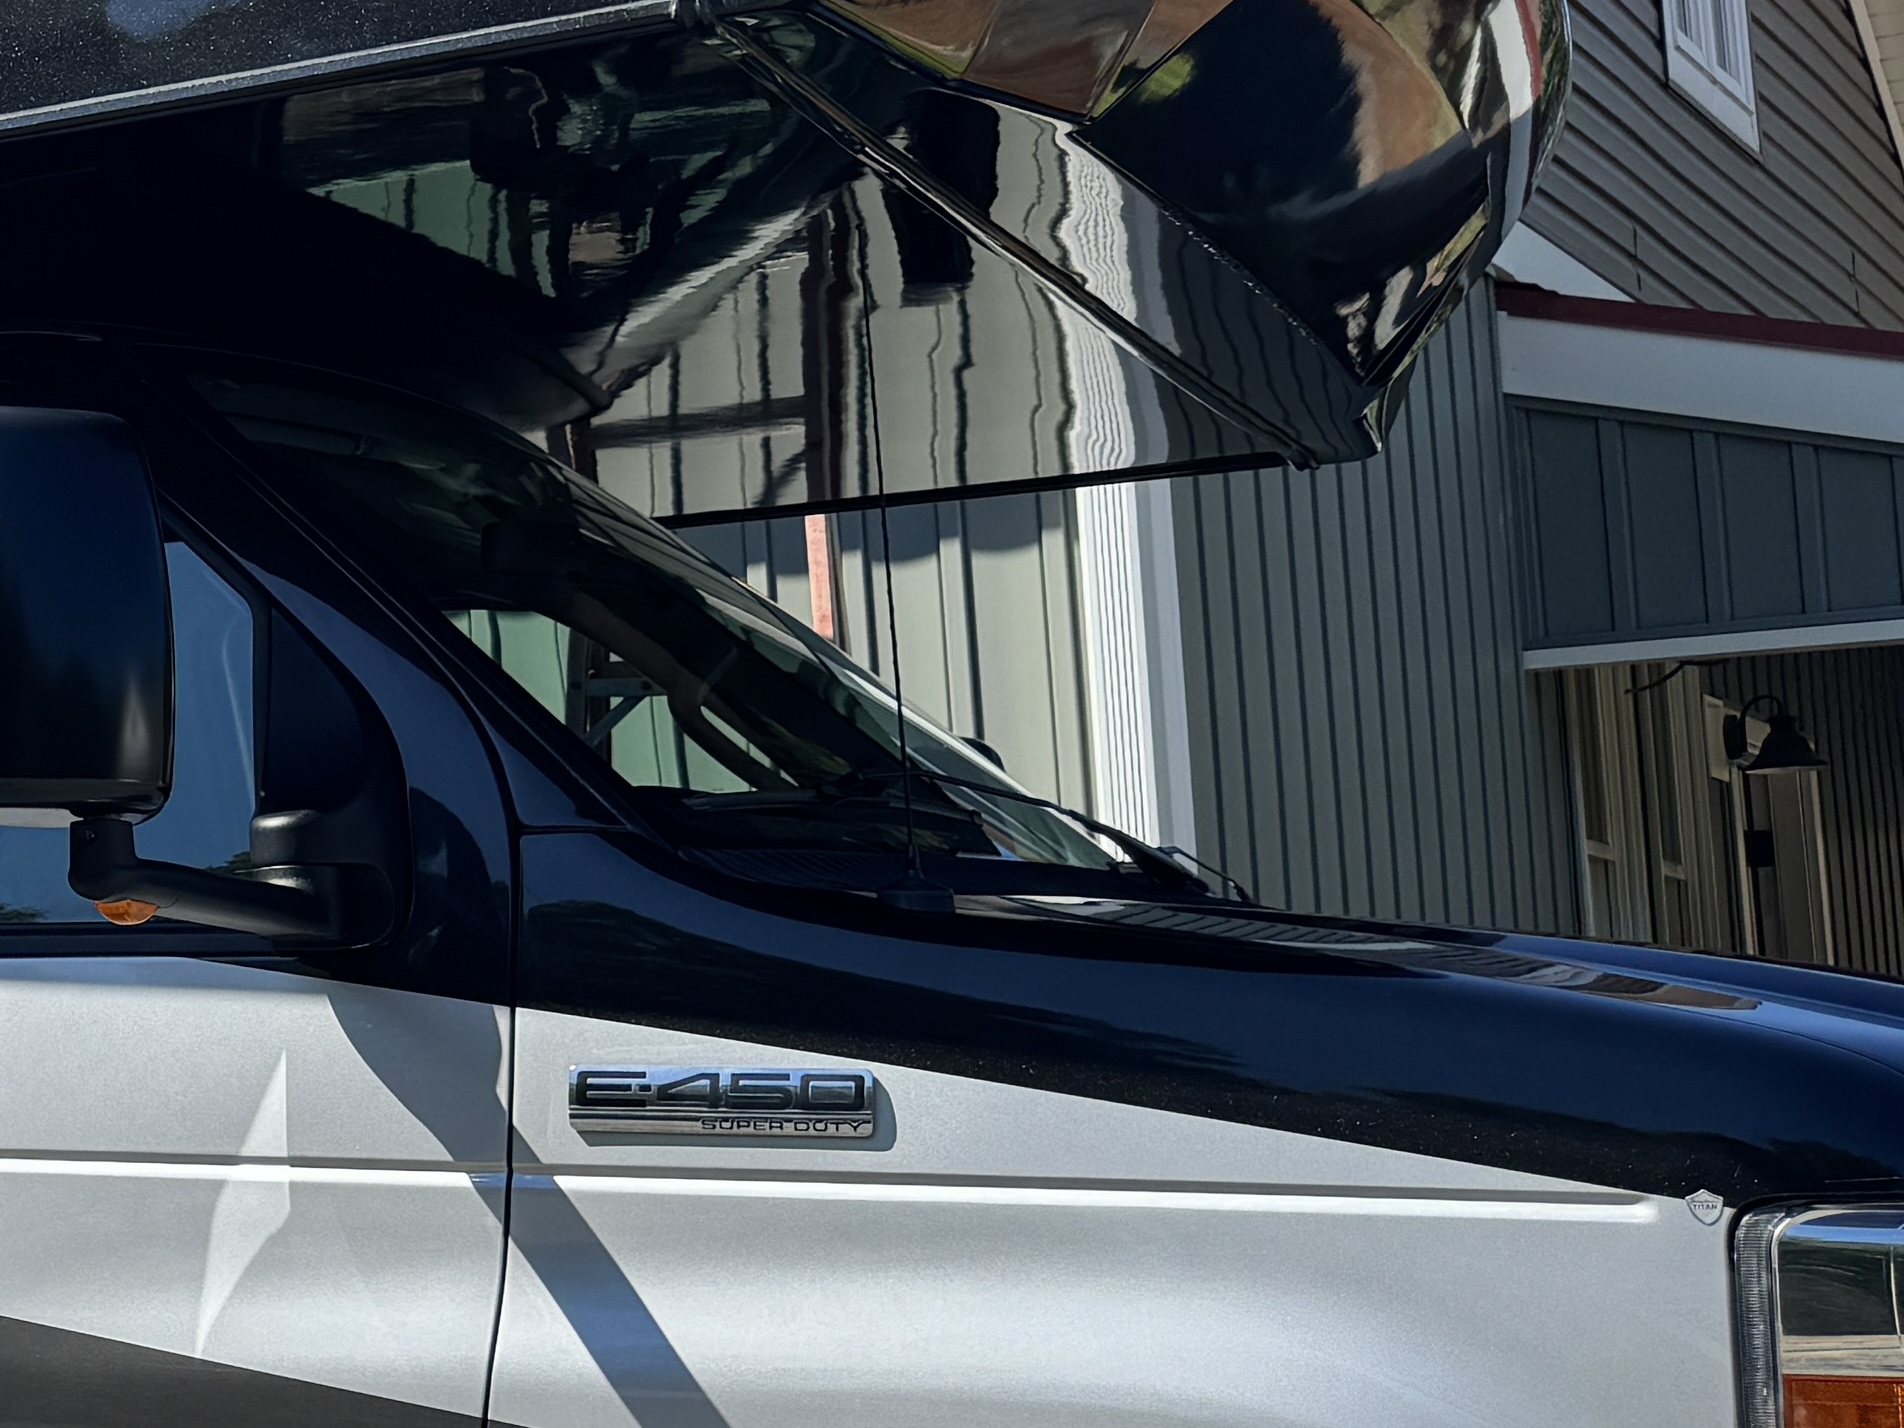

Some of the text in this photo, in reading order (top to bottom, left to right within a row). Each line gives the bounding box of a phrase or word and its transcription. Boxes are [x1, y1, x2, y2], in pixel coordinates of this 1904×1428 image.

[576, 1070, 866, 1110] E-450
[699, 1118, 864, 1133] SUPER DUTY
[1693, 1203, 1718, 1211] TITAN
